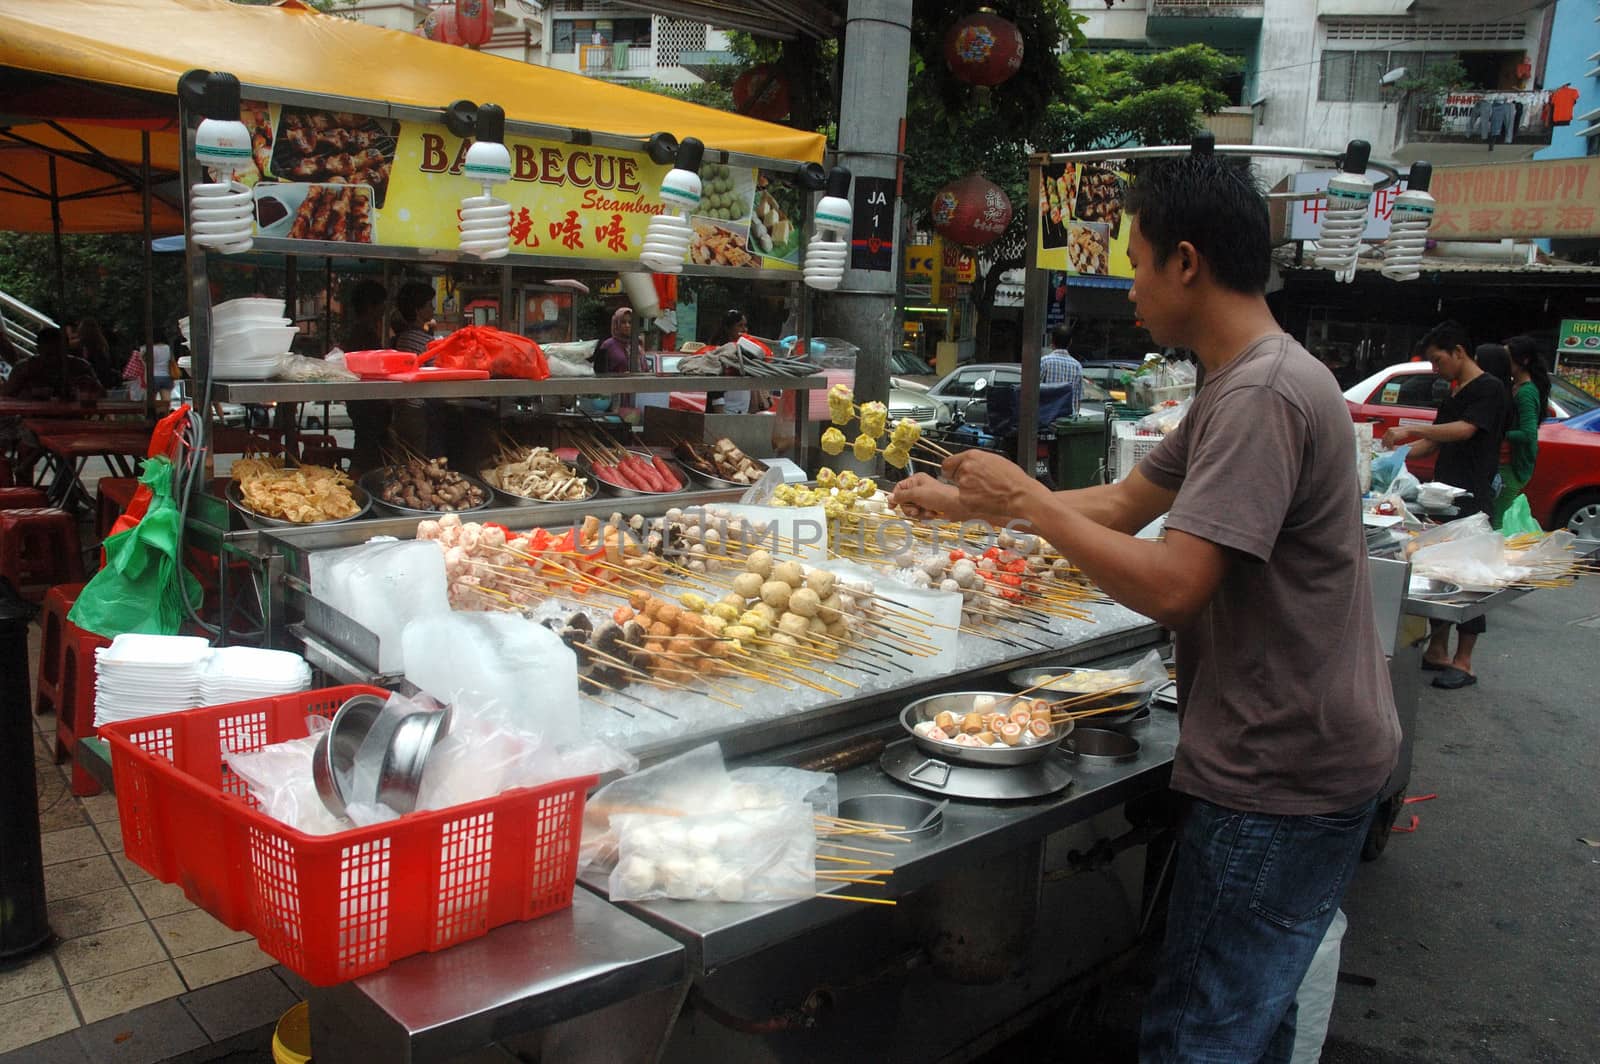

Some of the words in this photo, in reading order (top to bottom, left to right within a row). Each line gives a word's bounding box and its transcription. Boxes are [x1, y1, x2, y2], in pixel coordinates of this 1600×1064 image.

[419, 133, 641, 194] BABECUE
[1526, 164, 1591, 200] HAPPY
[581, 188, 666, 215] Steamboat
[867, 191, 887, 205] JA
[872, 214, 880, 228] 1
